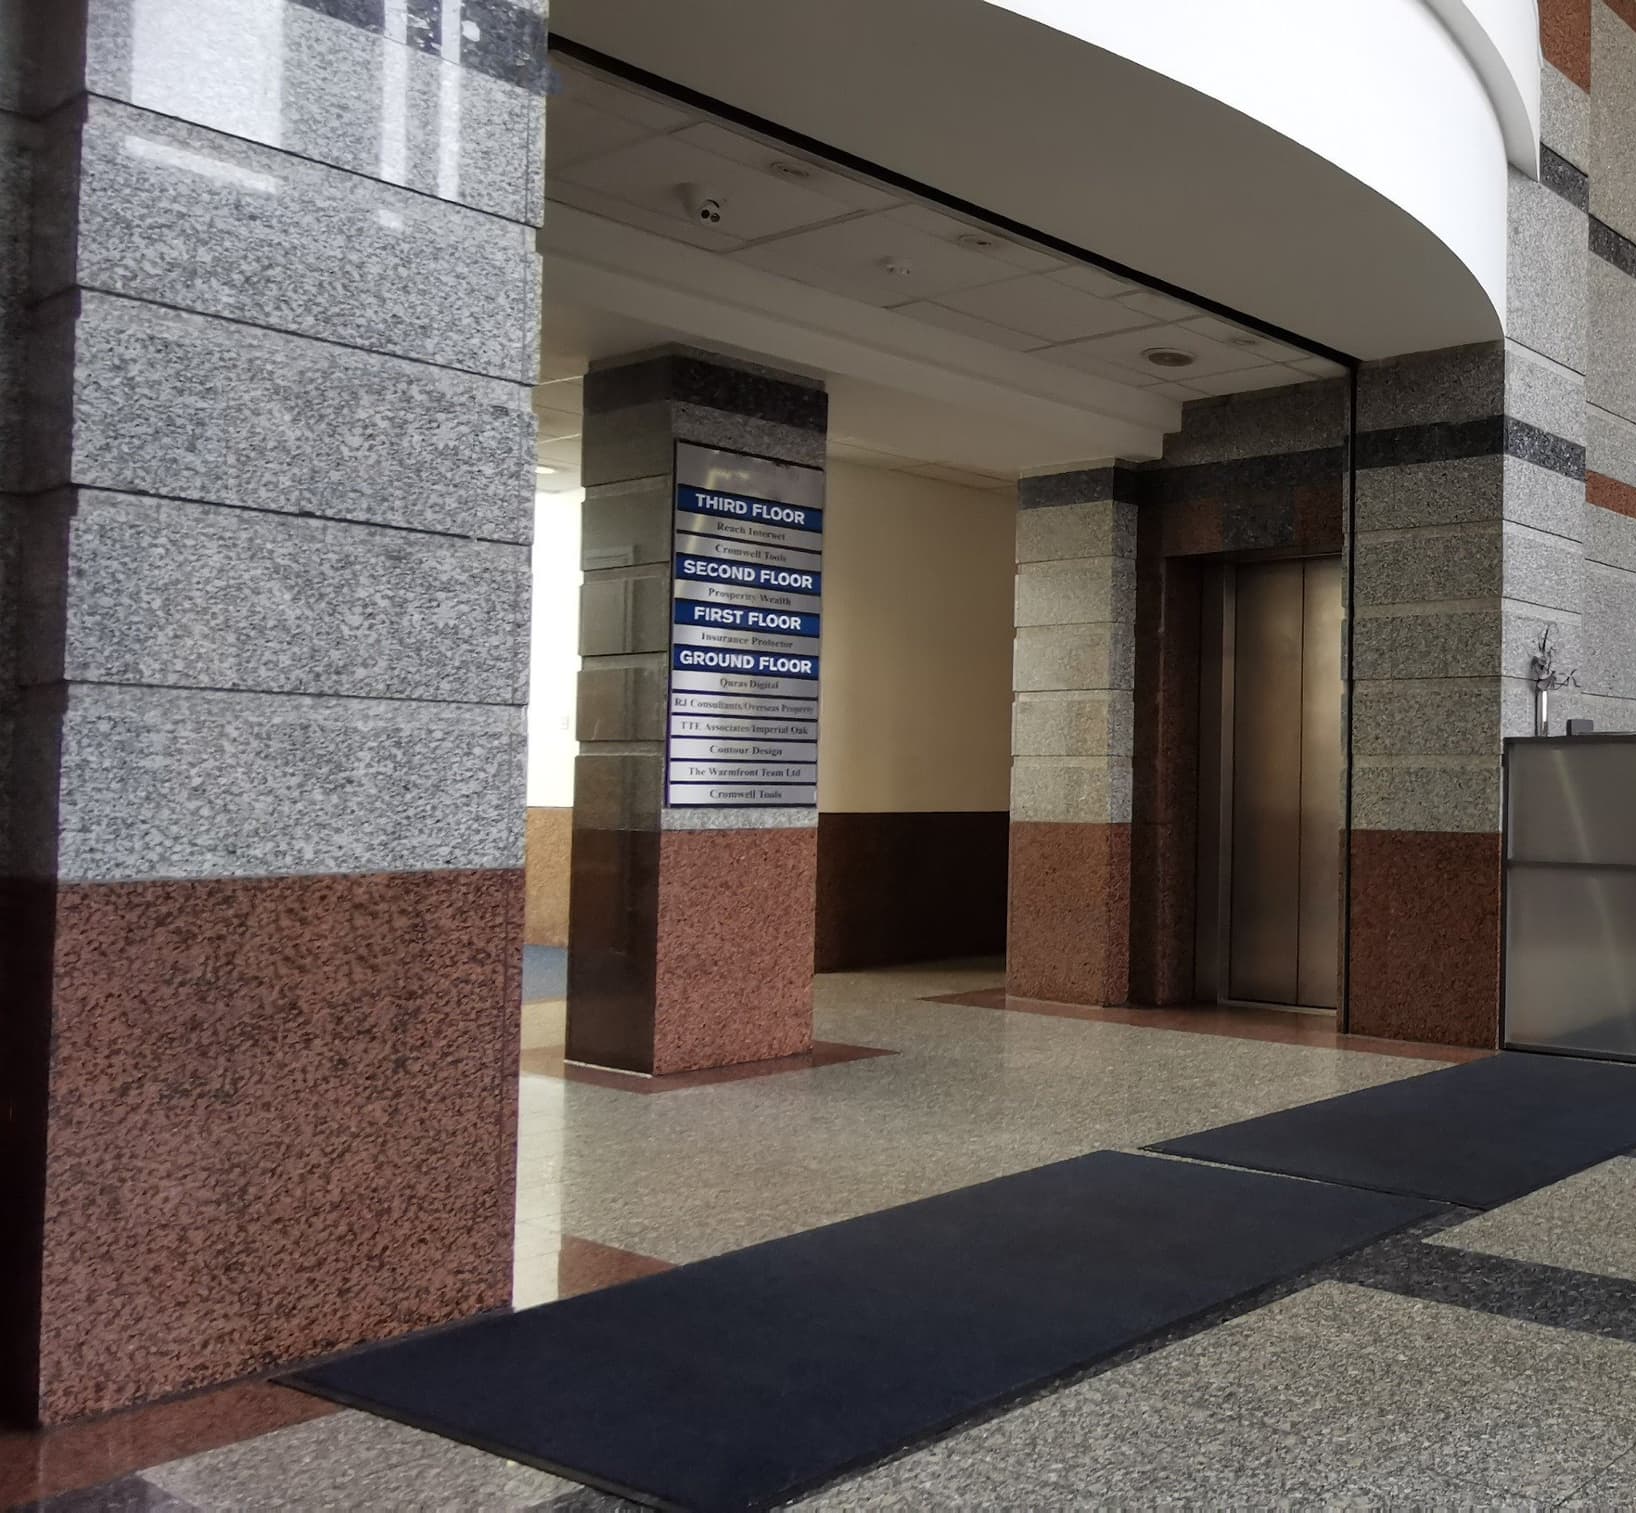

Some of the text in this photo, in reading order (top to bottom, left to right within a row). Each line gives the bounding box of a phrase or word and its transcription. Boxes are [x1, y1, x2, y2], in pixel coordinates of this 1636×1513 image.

[696, 494, 805, 525] THIRD FLOOR
[717, 522, 786, 541] Reach Internet
[715, 544, 786, 562] Cromwell Tools
[684, 560, 813, 589] SECOND FLOOR
[708, 588, 791, 606] Prosperity Wealth
[694, 607, 801, 630] FIRST FLOOR
[701, 633, 793, 648] Insurance Protector
[680, 651, 811, 673] GROUND FLOOR
[750, 681, 779, 689] Digital
[675, 698, 687, 706] RJ
[791, 726, 808, 735] Oak
[710, 745, 782, 756] Contour Design
[689, 767, 800, 777] The Warmfront Team Ltd
[710, 790, 782, 800] Cromwell Tools
